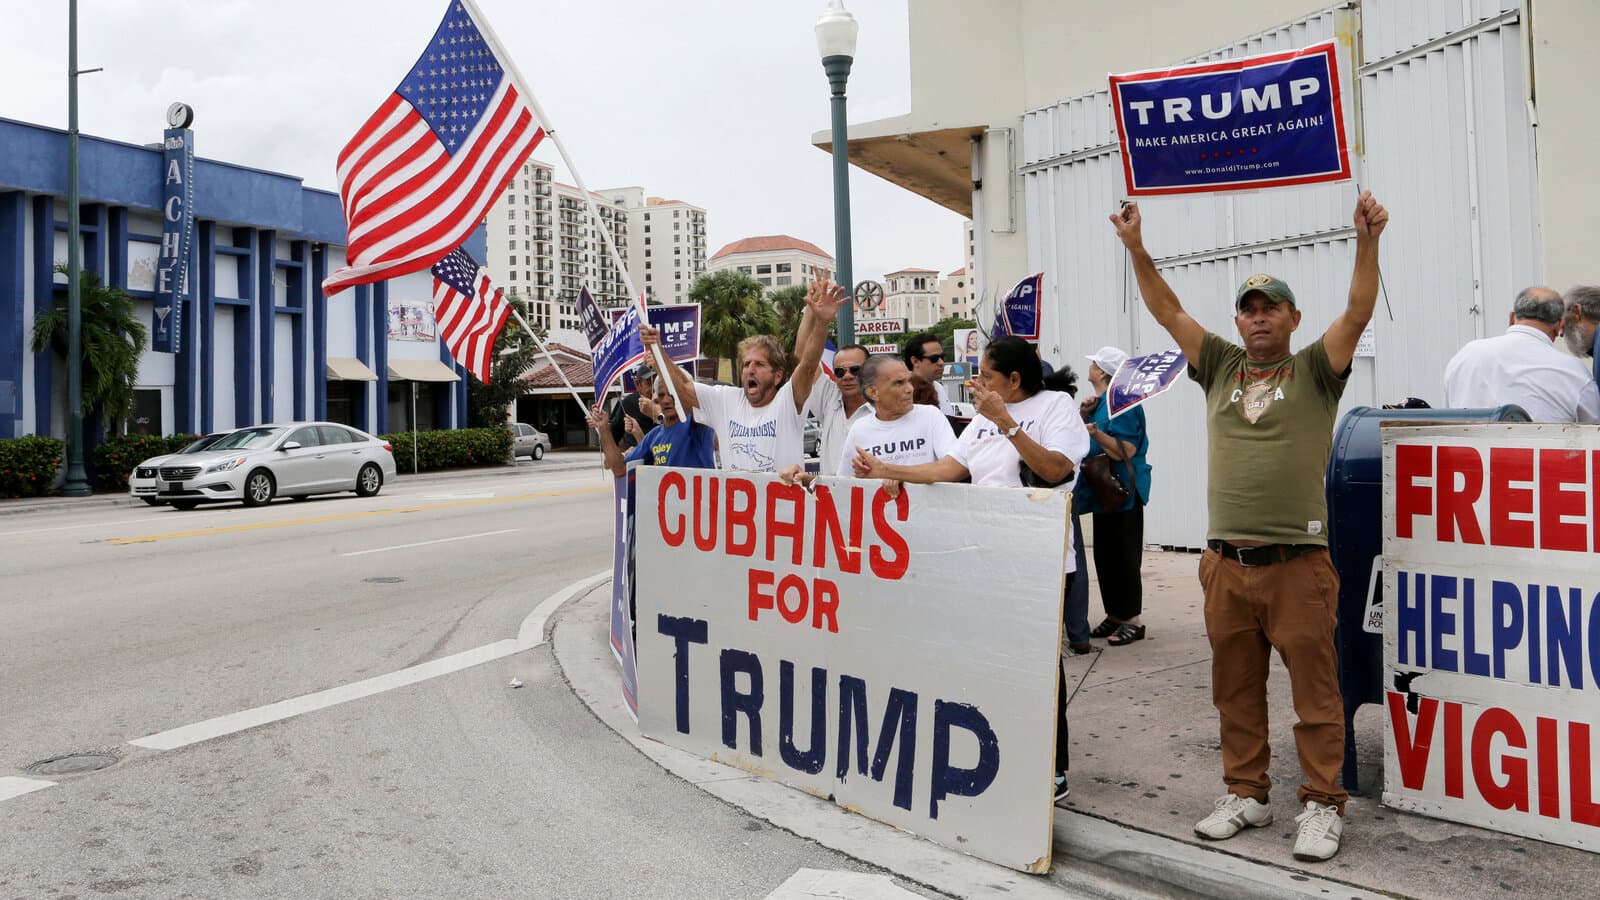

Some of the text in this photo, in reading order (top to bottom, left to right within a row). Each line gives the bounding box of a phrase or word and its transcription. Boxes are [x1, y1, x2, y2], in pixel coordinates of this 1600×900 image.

[1130, 77, 1321, 125] TRUMP
[1135, 114, 1324, 147] MAKE AMERICA GREAT AGAIN!
[853, 321, 901, 333] CARRETA
[867, 345, 896, 353] URANT
[658, 471, 910, 580] CUBANS
[1395, 444, 1600, 553] FREE
[748, 568, 840, 633] FOR
[657, 613, 1000, 820] TRUMP
